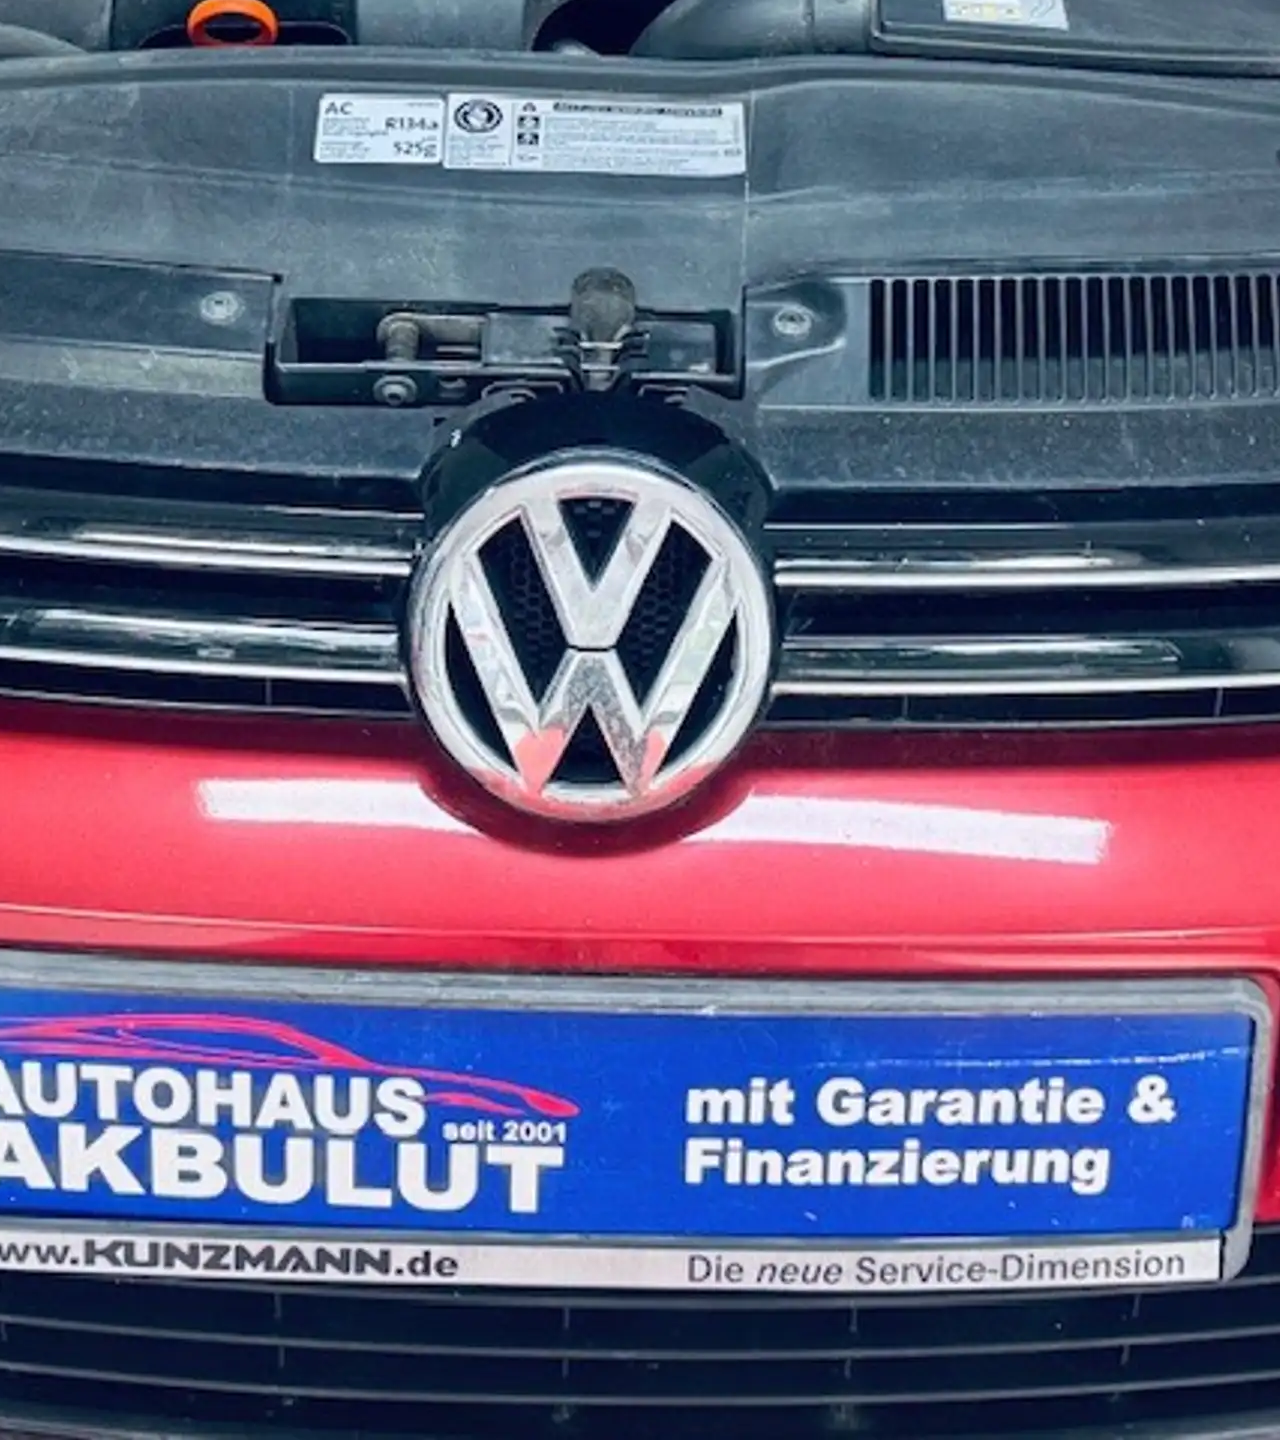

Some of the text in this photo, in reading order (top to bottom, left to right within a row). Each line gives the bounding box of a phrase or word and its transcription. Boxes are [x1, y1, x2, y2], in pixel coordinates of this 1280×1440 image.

[324, 101, 354, 116] AC
[685, 1074, 1177, 1127] mit Garantie &
[442, 1119, 568, 1144] seit 2001
[684, 1138, 1112, 1196] Finanzierung
[687, 1249, 1186, 1285] Die neue Service-Dimension
